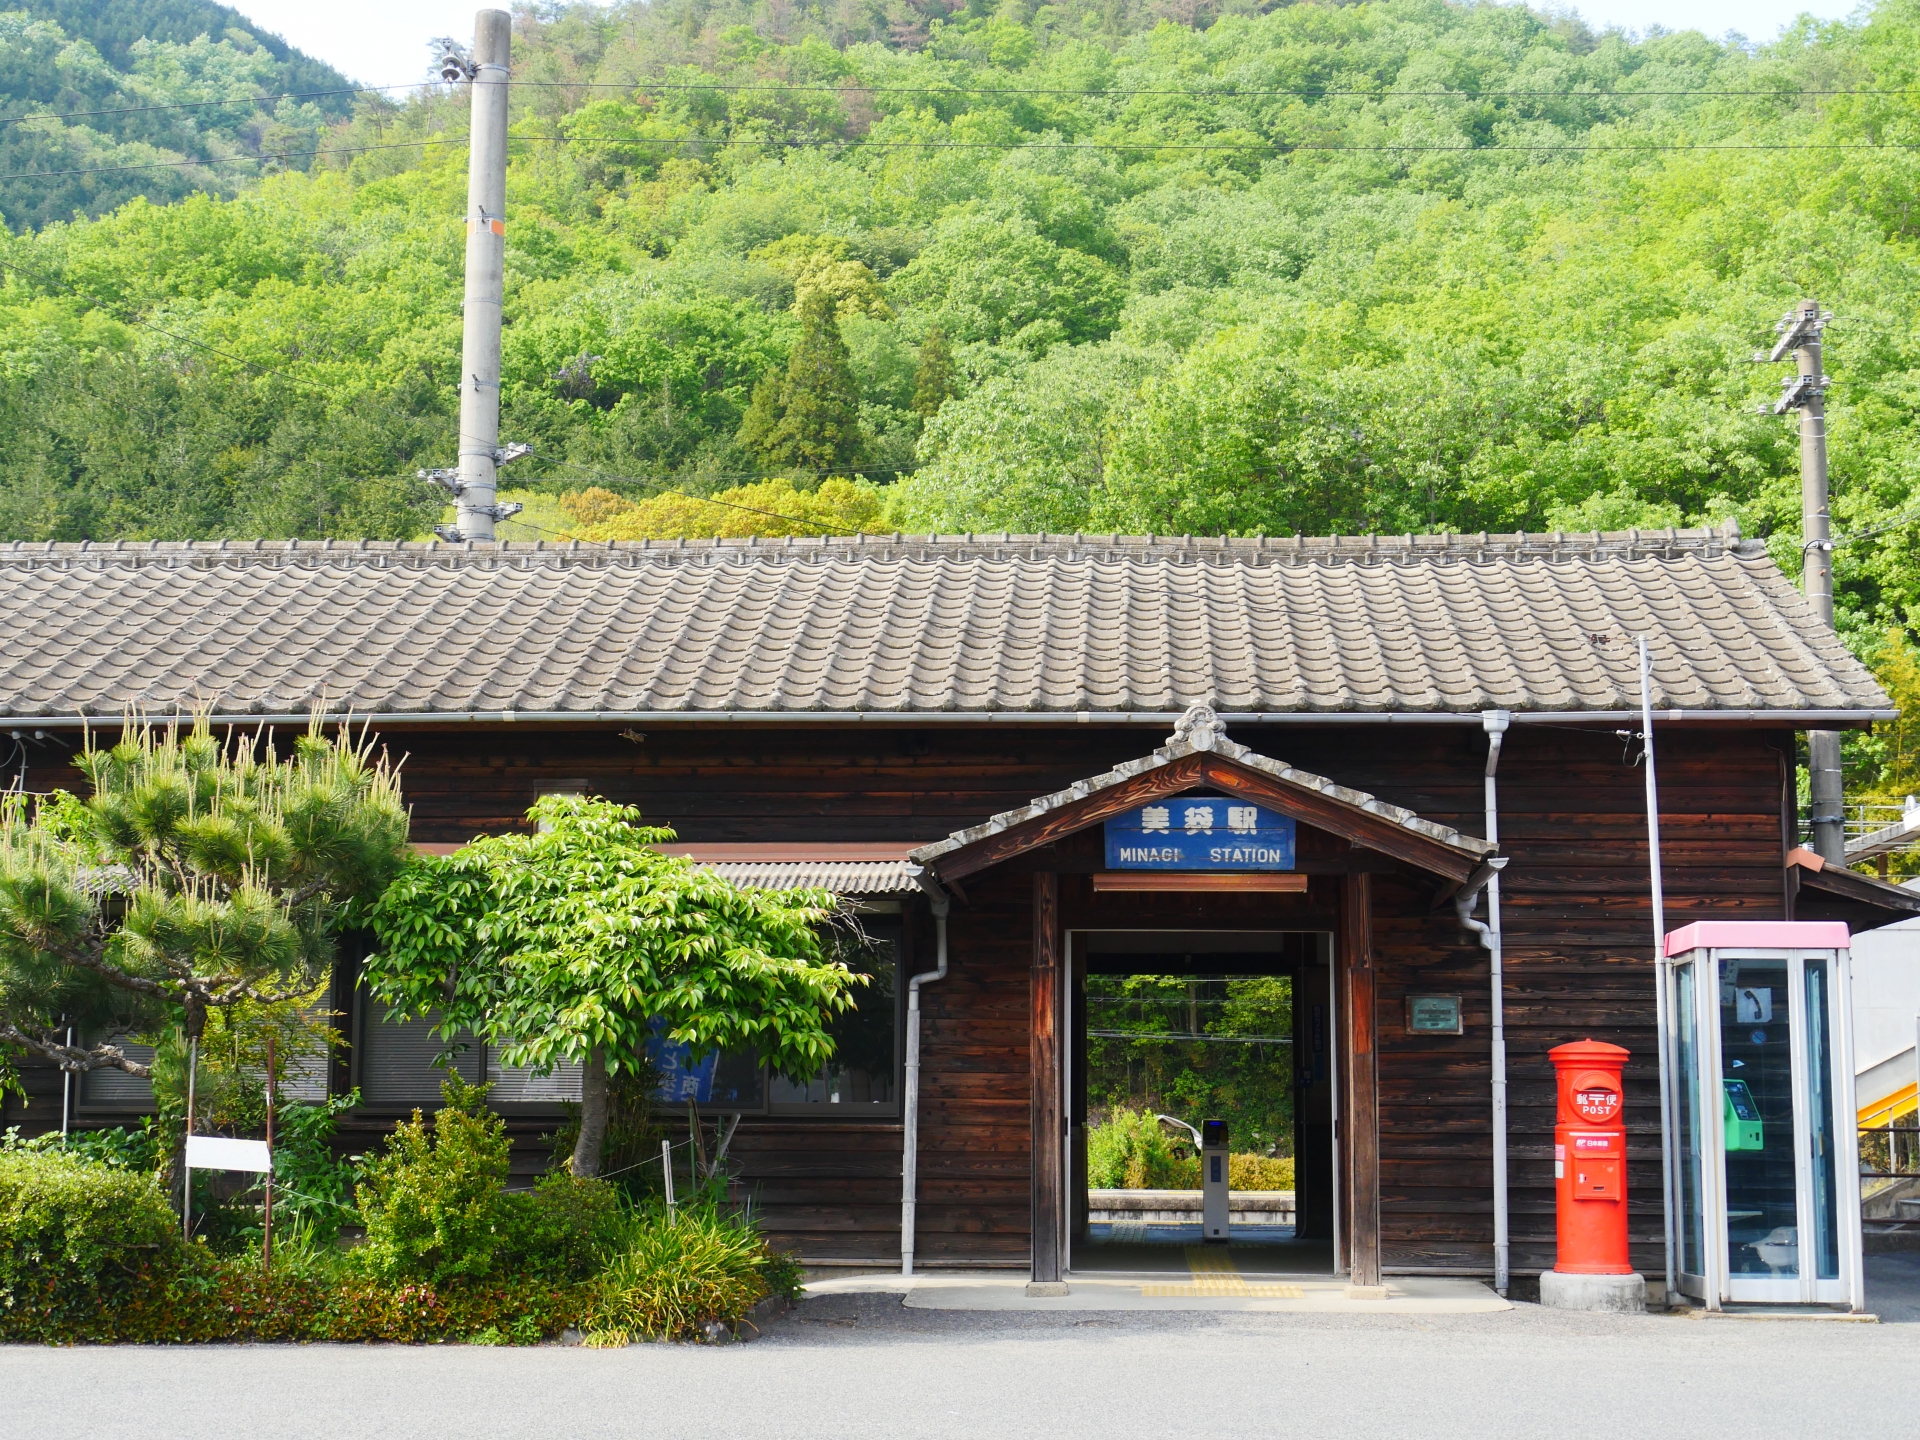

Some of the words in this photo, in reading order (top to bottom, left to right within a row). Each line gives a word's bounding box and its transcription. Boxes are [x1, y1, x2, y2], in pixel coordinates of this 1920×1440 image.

[1141, 805, 1258, 835] 美袋駅
[1120, 847, 1179, 863] MINAGI
[1210, 848, 1281, 863] STATION
[1583, 1106, 1611, 1114] POST
